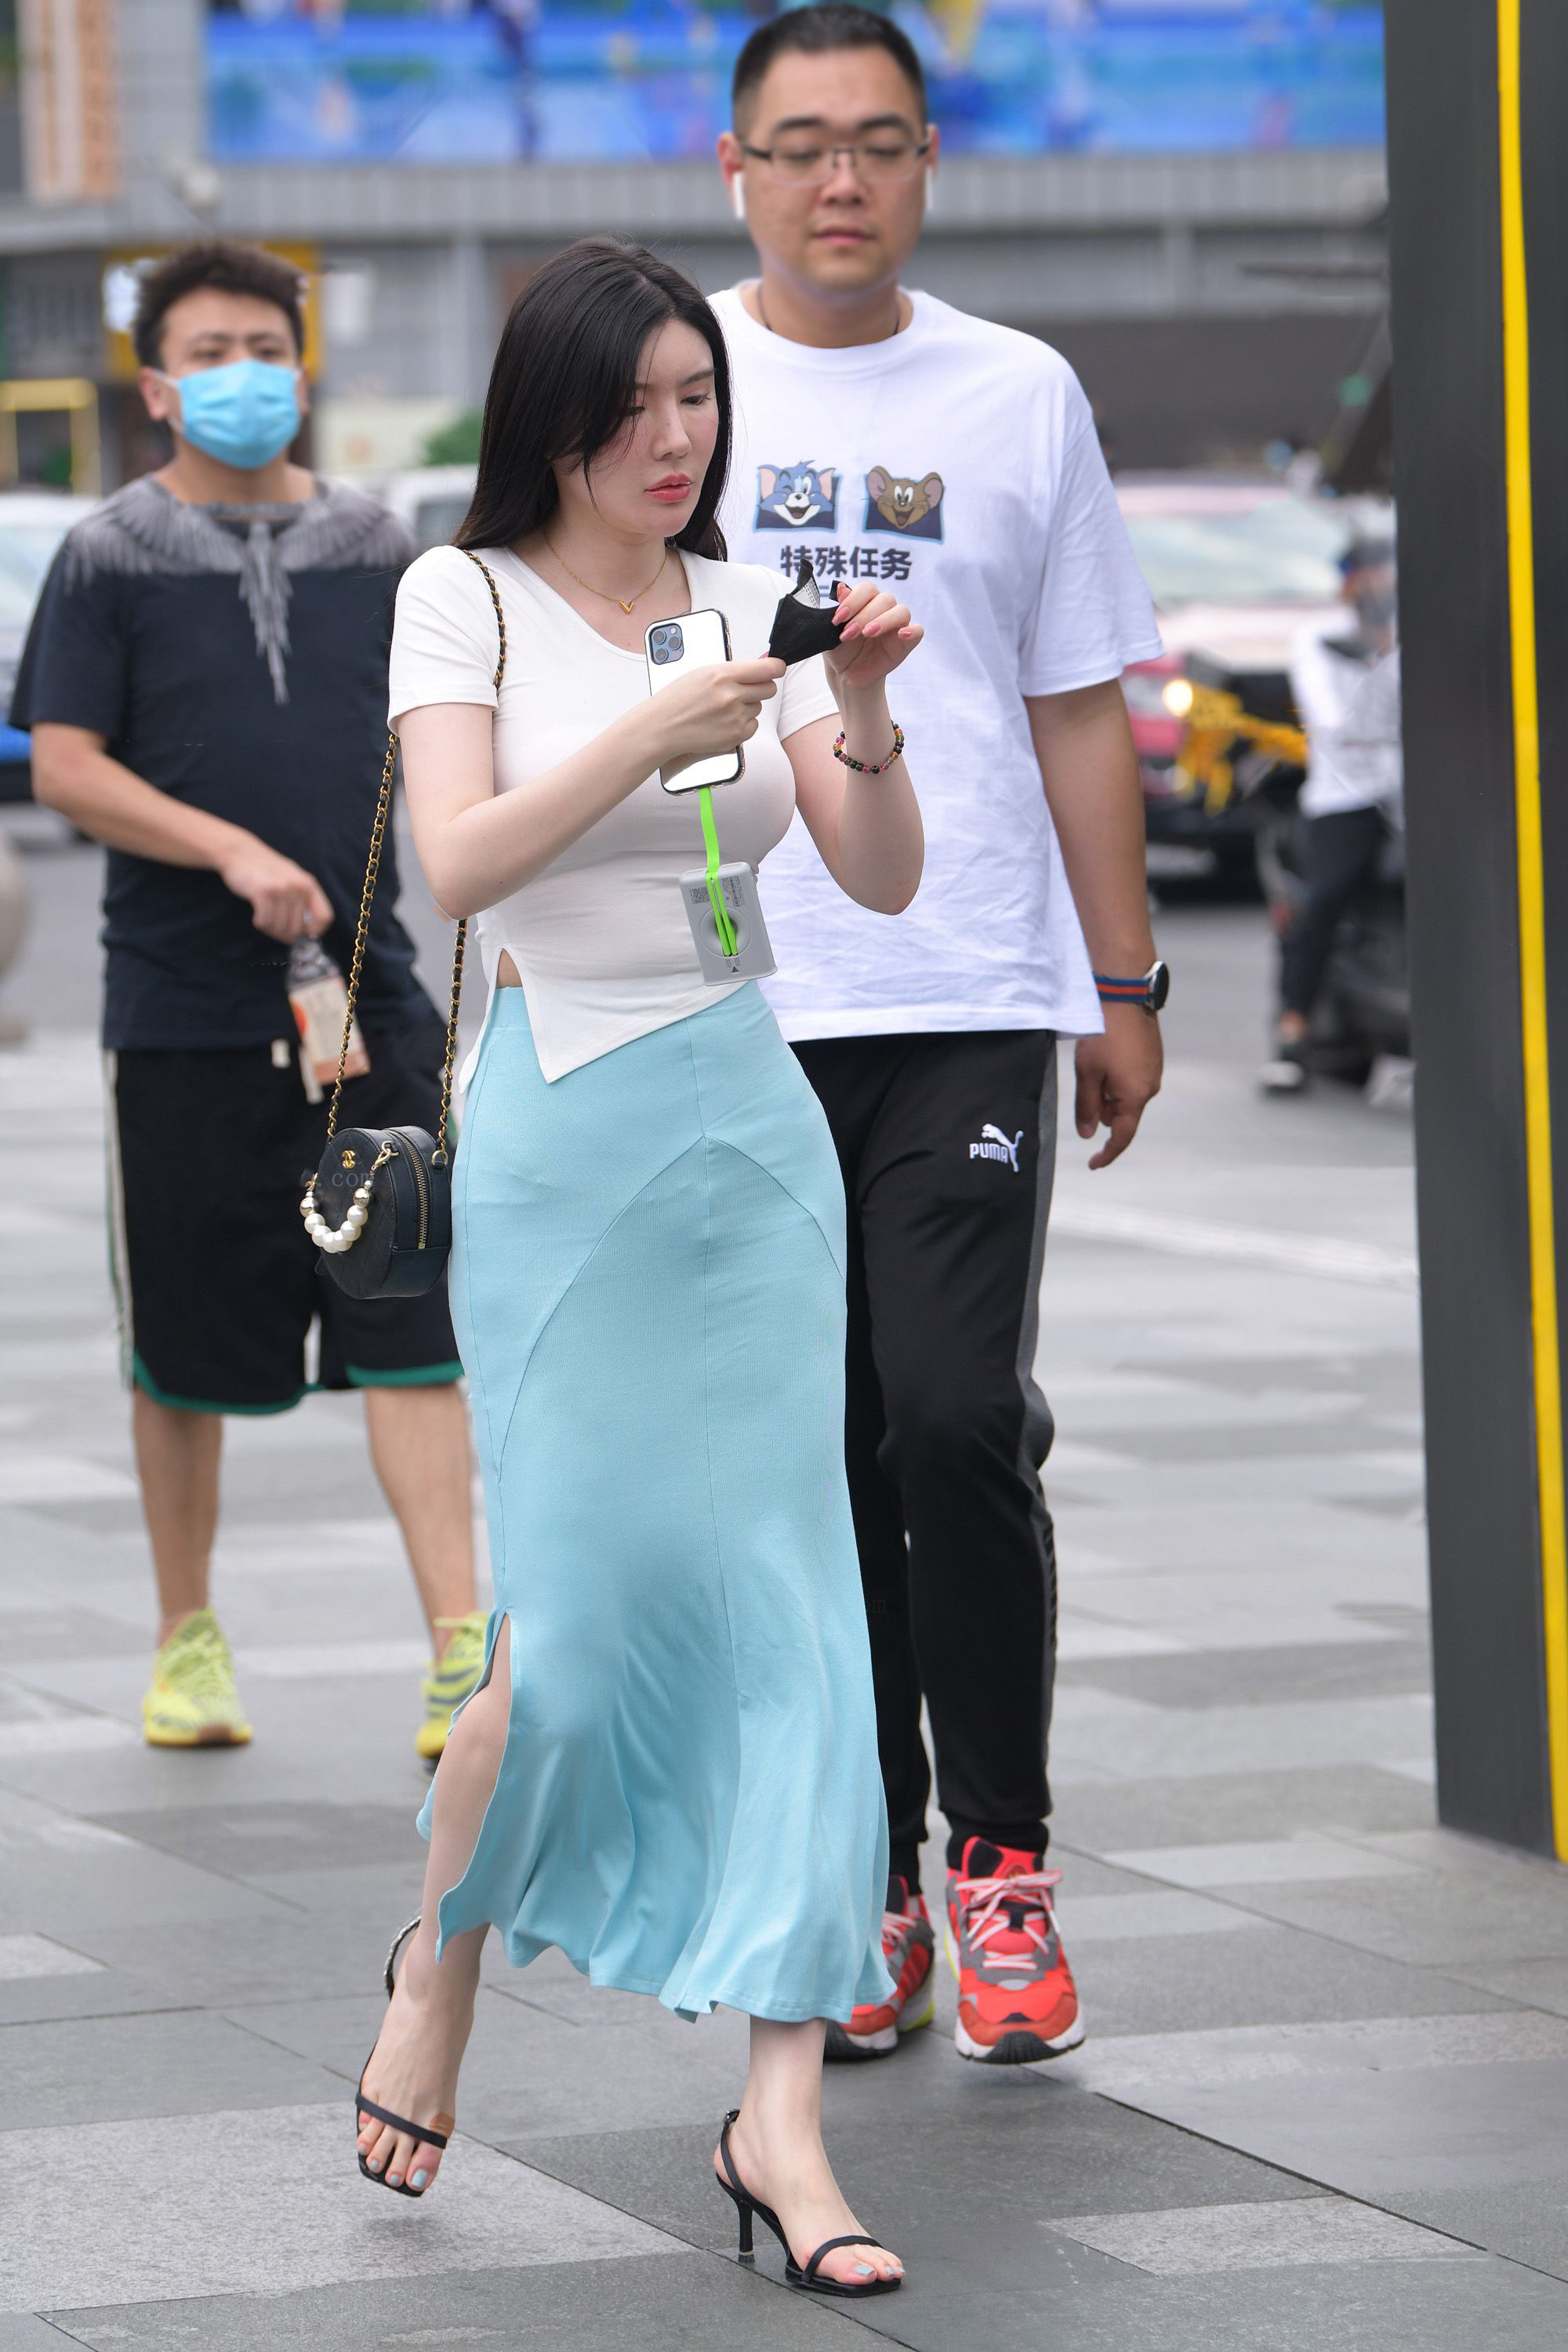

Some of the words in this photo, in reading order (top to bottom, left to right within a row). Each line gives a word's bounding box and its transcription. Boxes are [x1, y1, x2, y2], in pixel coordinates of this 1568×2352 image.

[780, 545, 913, 581] 特殊任务
[969, 1142, 1009, 1163] PUMA
